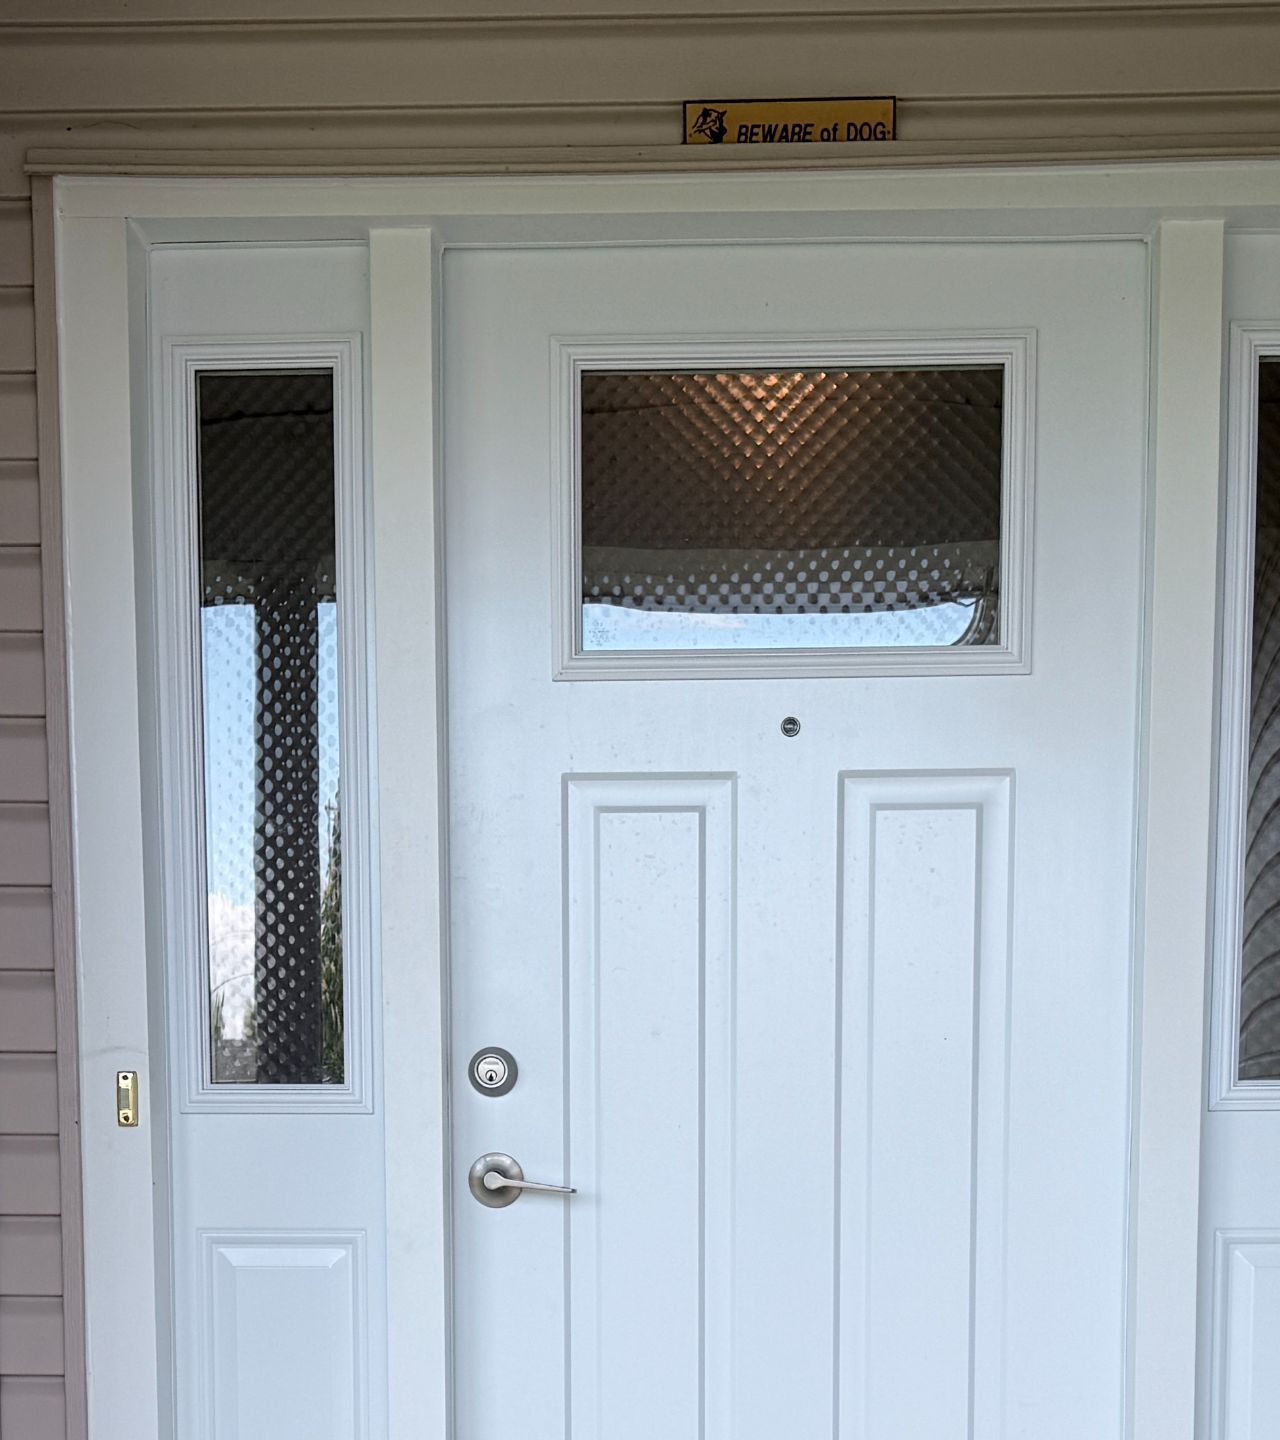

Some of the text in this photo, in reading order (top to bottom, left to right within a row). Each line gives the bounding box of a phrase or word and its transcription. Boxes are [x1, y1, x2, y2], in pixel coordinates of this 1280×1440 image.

[737, 122, 887, 144] BEWARE of DOG
